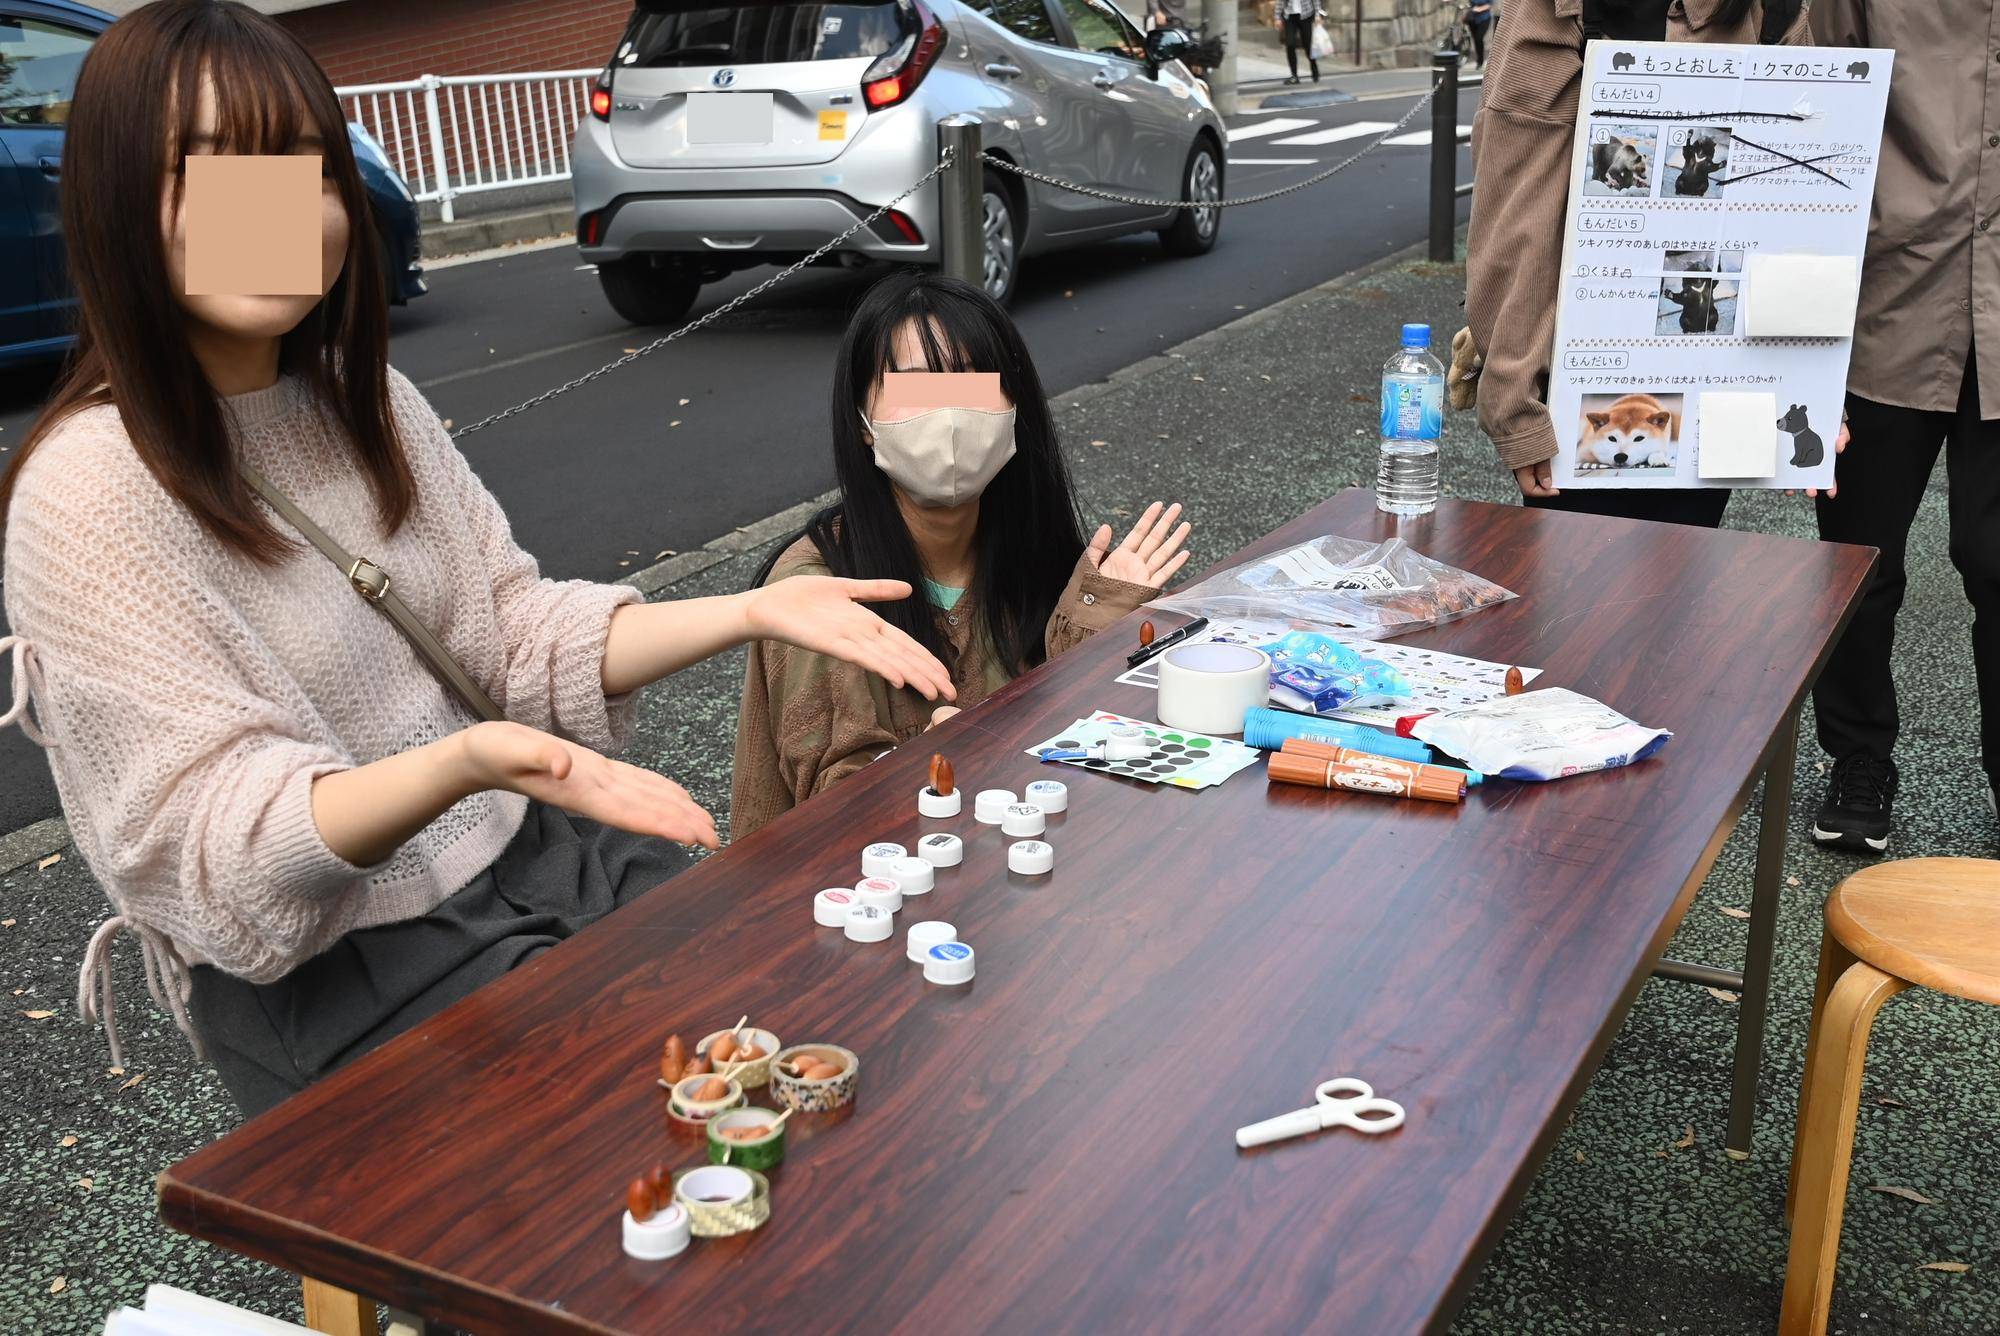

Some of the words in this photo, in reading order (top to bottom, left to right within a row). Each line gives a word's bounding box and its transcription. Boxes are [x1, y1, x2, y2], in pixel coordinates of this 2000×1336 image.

[1599, 87, 1654, 100] もんだい4
[1584, 217, 1638, 230] もんだい5
[1577, 239, 1759, 250] ツキノワグマのあしのはやさはどくらい？
[1569, 356, 1623, 367] もんだい6
[1351, 777, 1388, 789] マッキー
